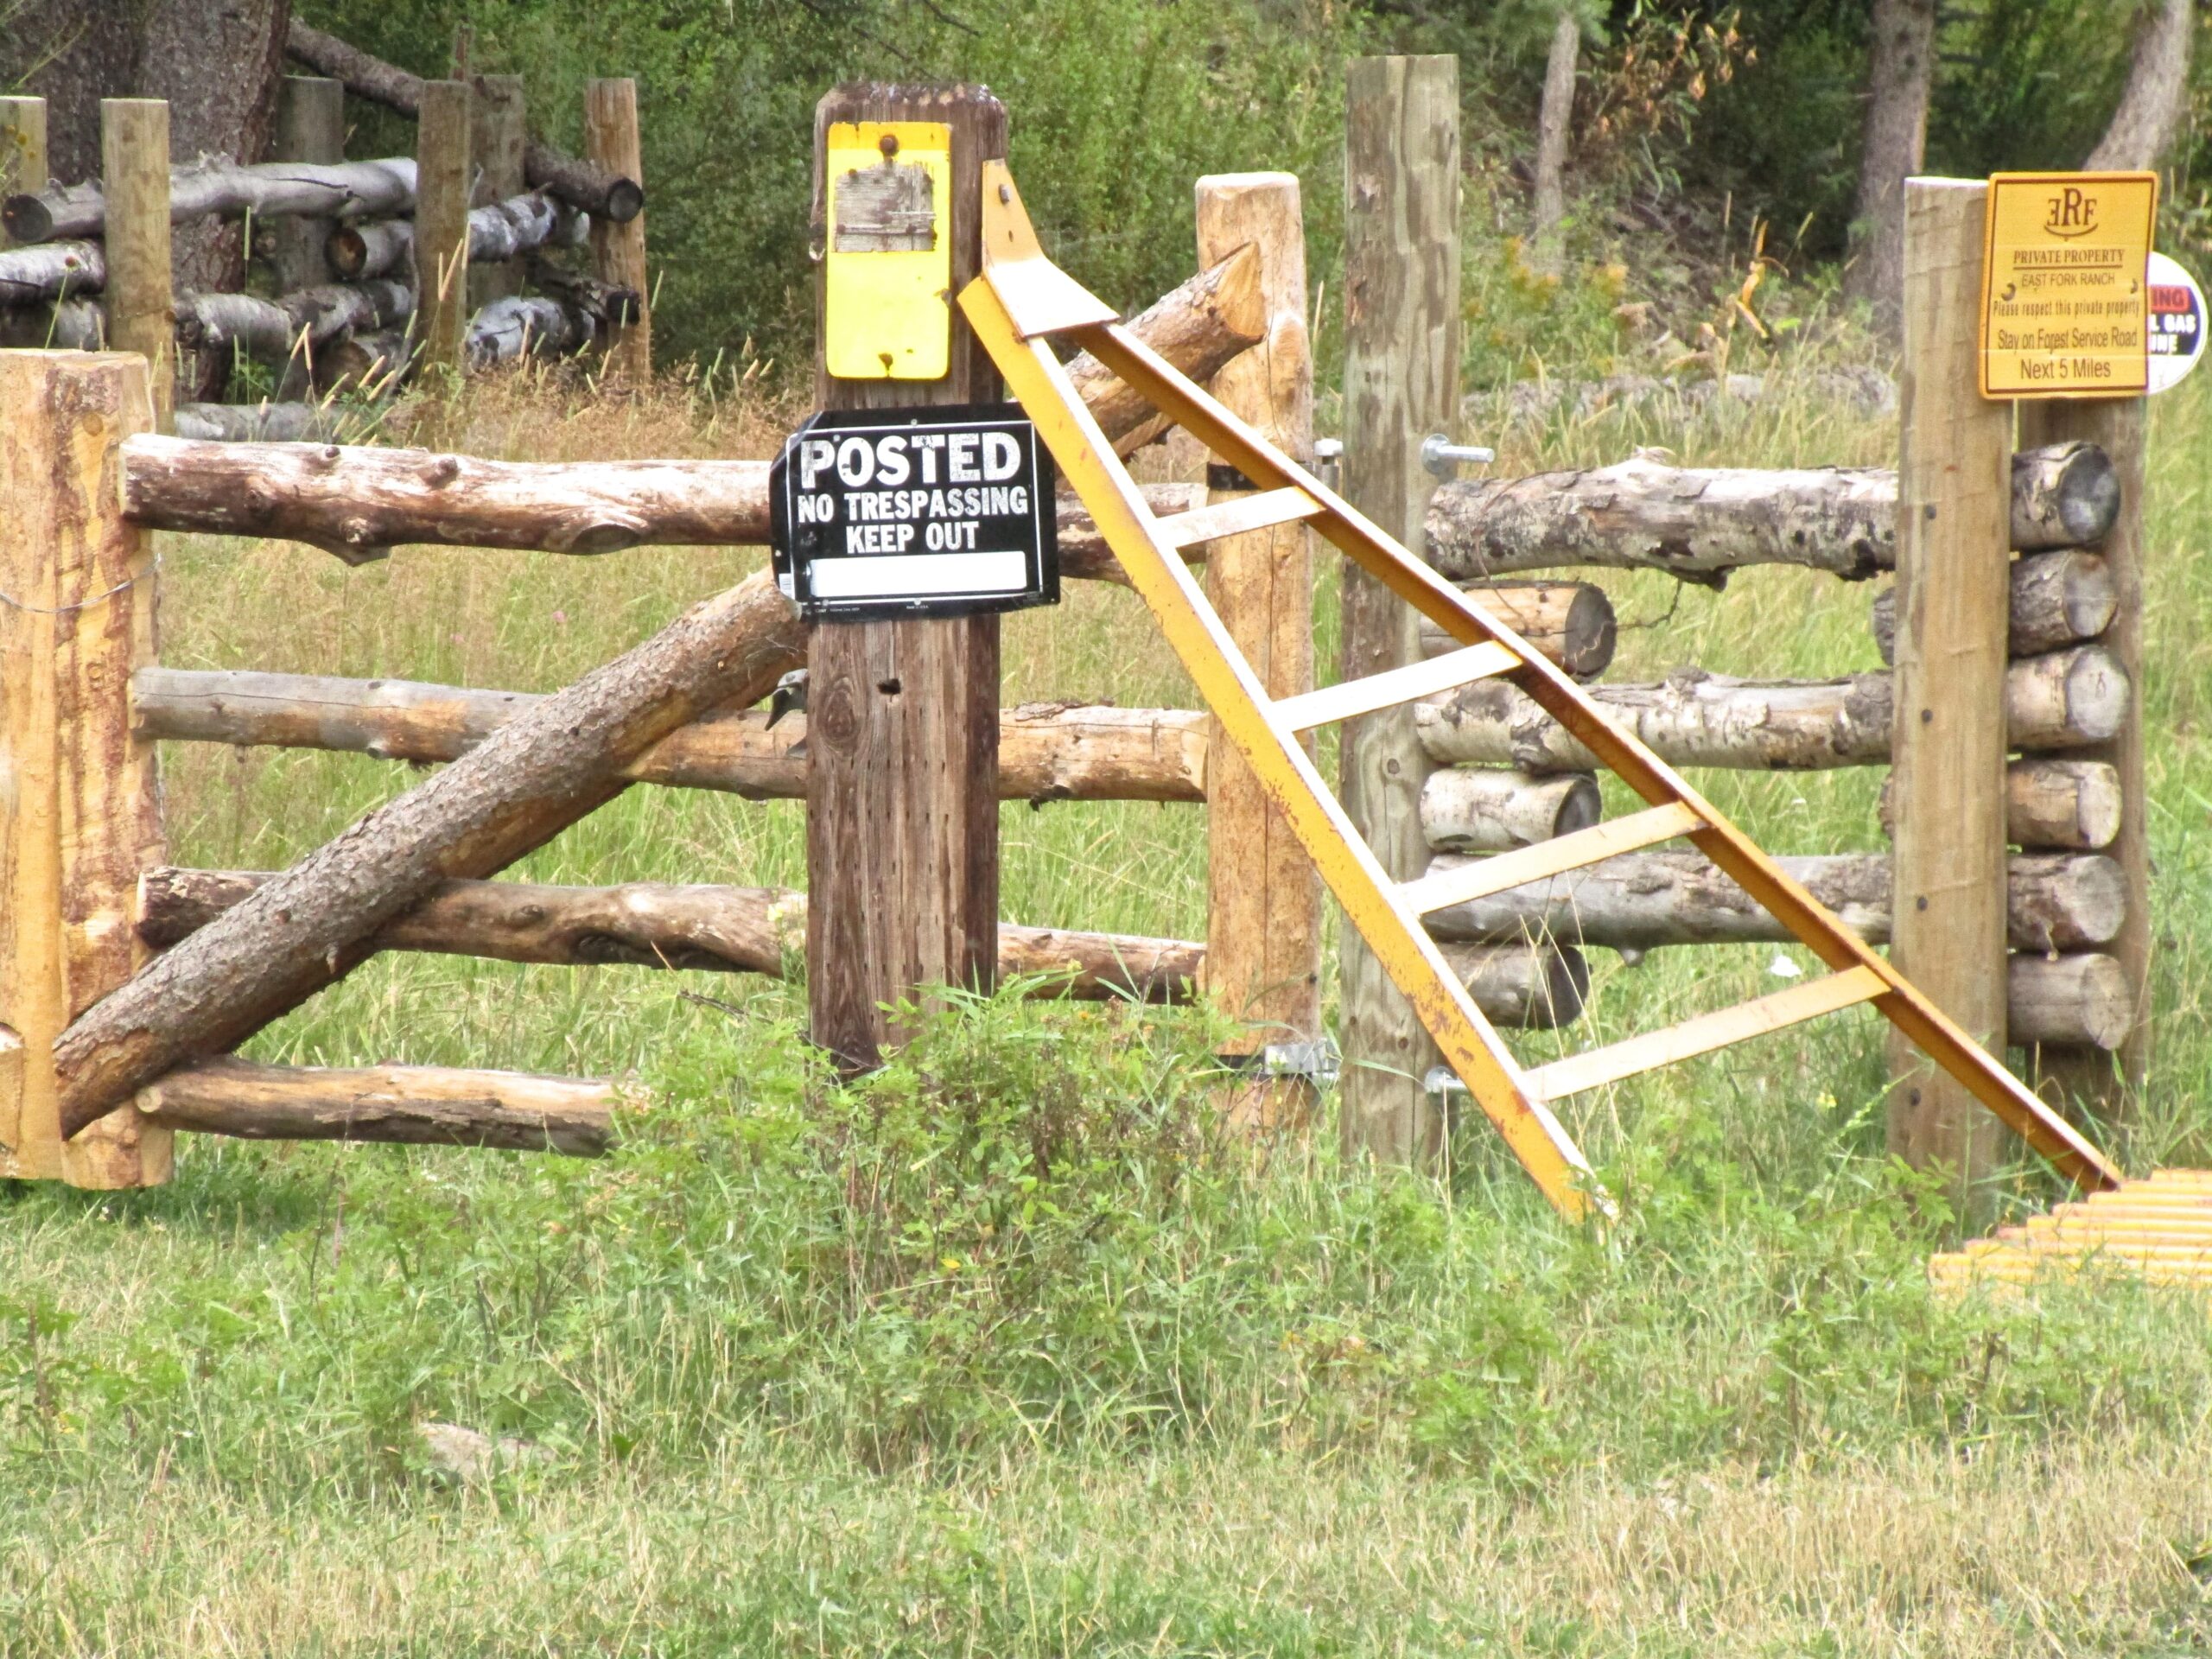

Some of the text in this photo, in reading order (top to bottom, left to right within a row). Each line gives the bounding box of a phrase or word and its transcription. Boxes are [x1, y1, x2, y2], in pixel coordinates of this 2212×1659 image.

[2013, 248, 2125, 264] PRIVATE PROPERTY
[2021, 272, 2115, 287] EAST FORK RANCH
[2152, 288, 2184, 307] ING
[1993, 300, 2139, 319] Please respect this private property
[2164, 314, 2196, 334] GAS
[1998, 327, 2138, 354] Stay on Forest Service Road
[2021, 358, 2111, 379] Next 5 Miles
[800, 432, 1021, 489] POSTED
[798, 486, 1028, 523] NO TRESPASSING
[846, 521, 979, 554] KEEP OUT
